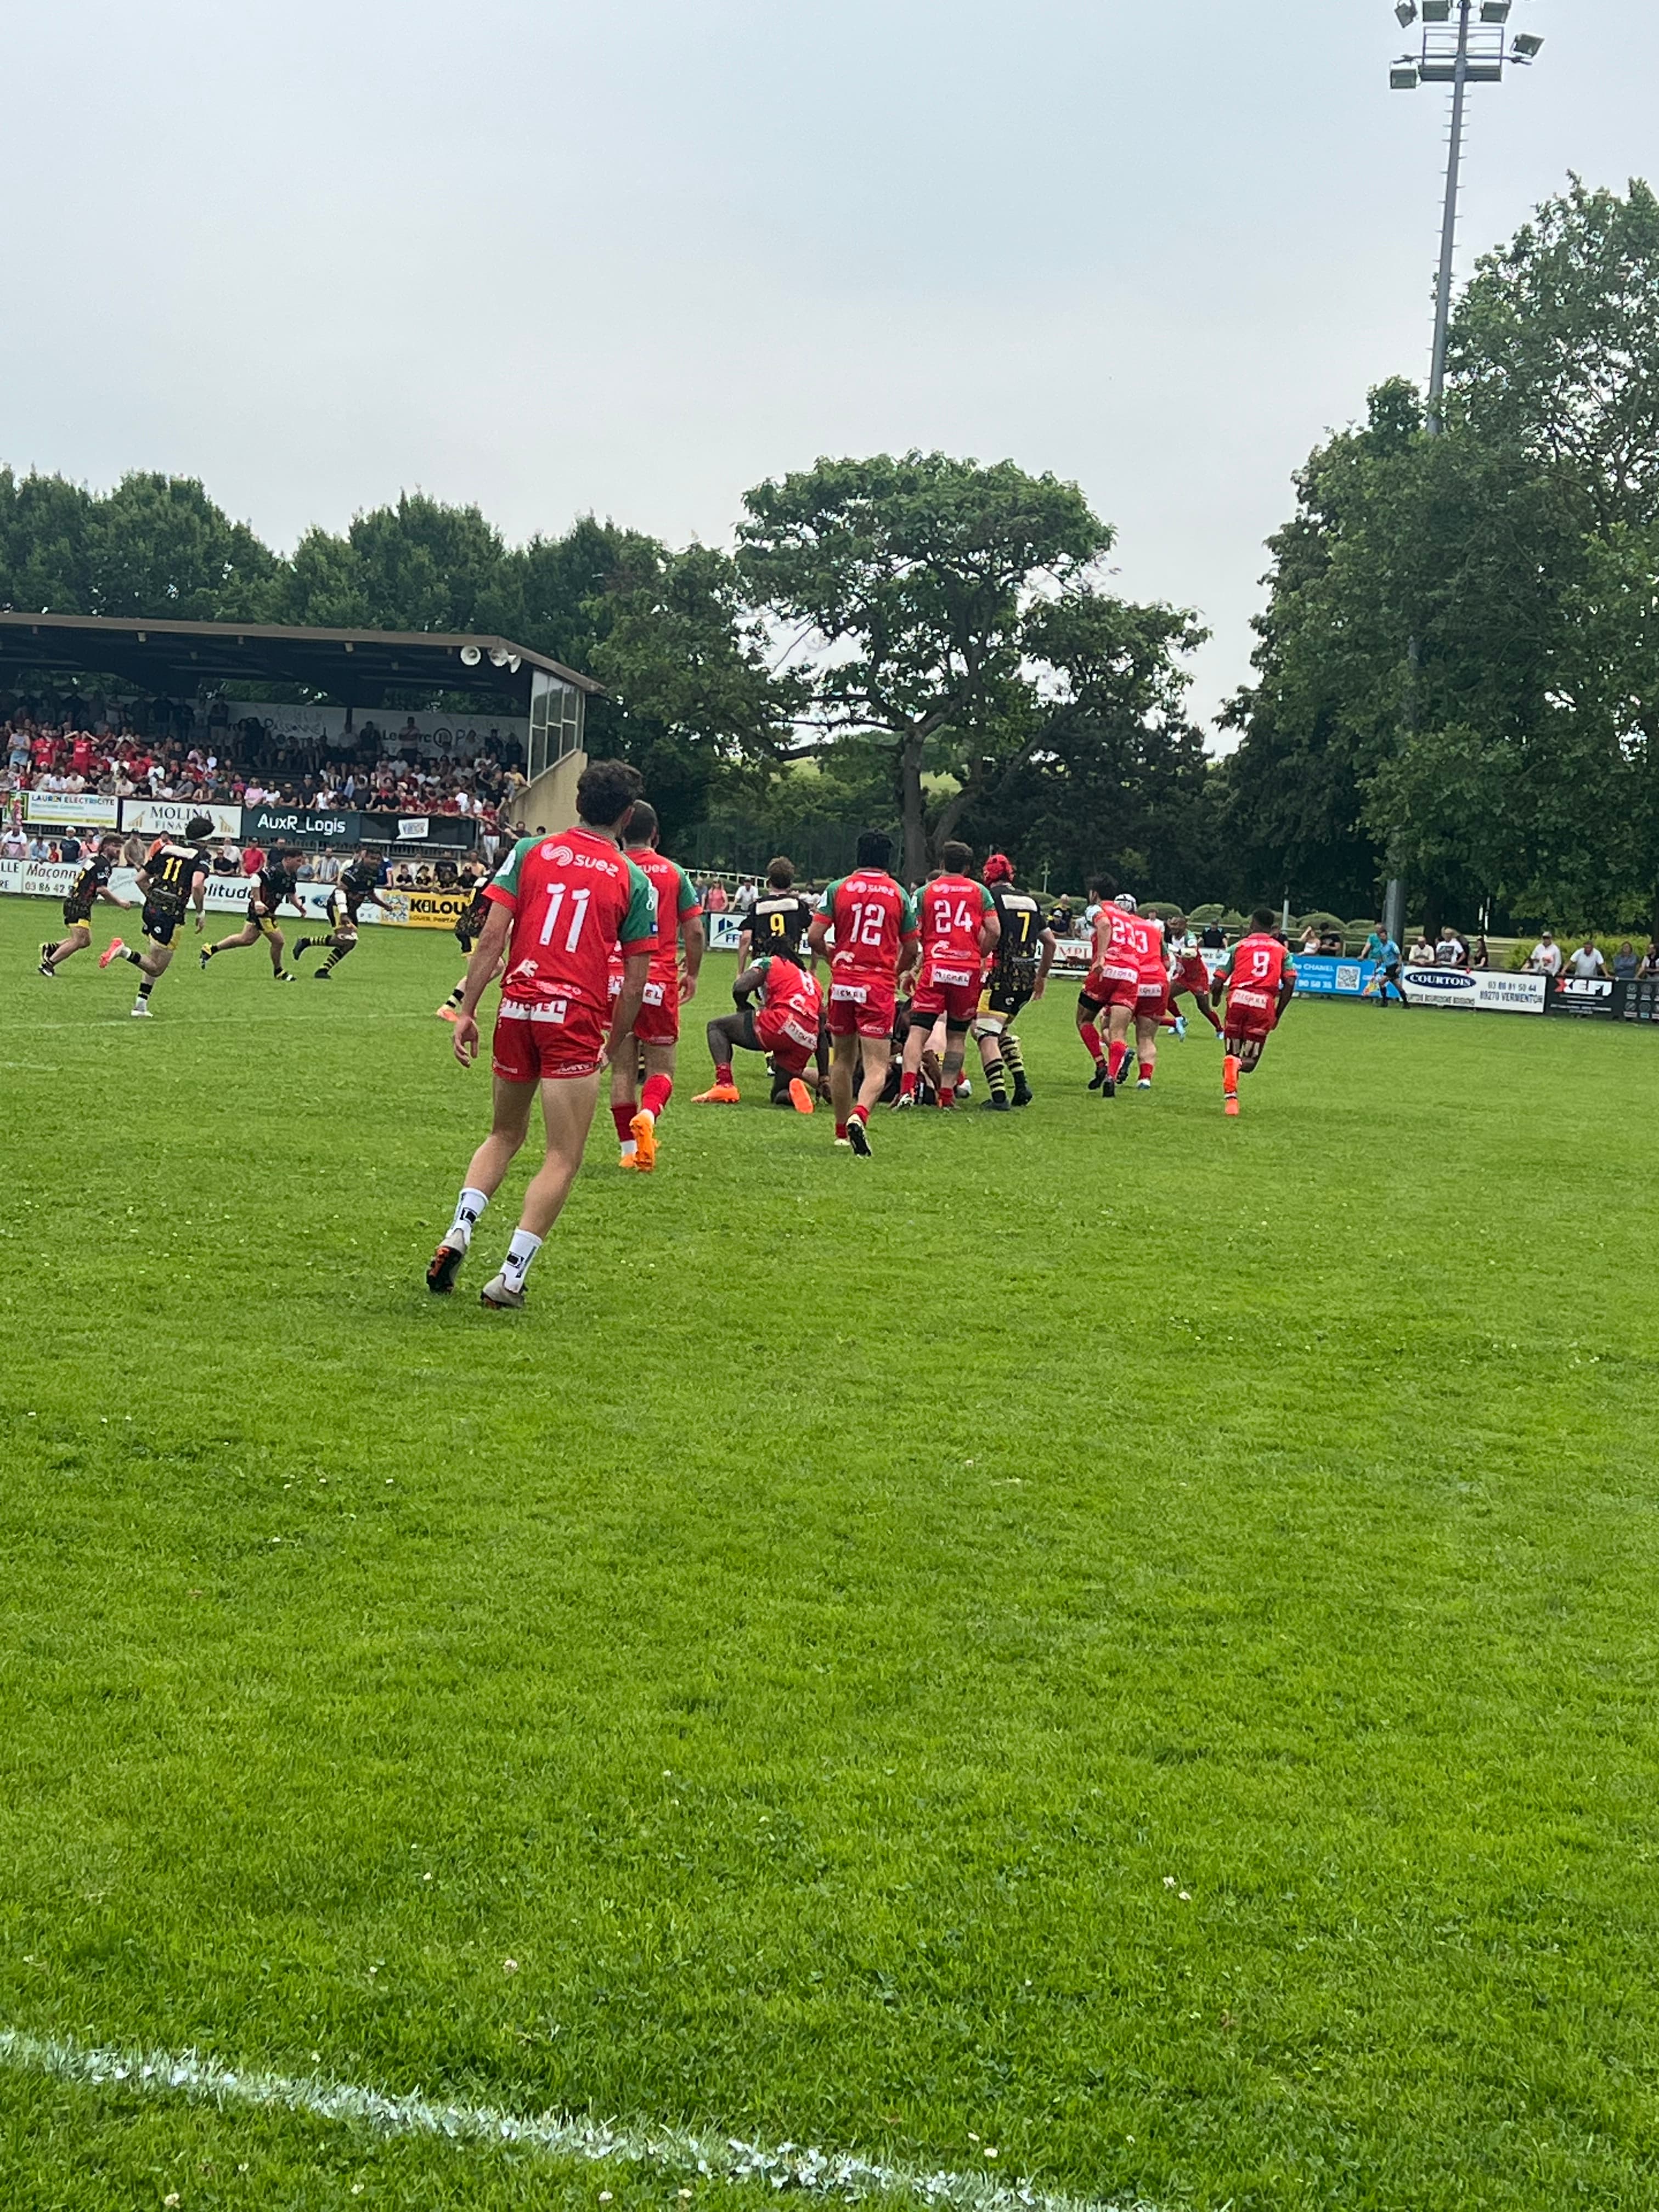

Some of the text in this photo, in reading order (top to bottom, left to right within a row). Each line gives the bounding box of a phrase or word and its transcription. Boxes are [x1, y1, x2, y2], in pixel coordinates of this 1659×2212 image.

[150, 806, 212, 822] MOLINA
[155, 820, 188, 830] FINA
[257, 813, 346, 836] AuxR_Logis
[26, 863, 77, 881] Maçonn
[162, 857, 183, 882] 11
[572, 854, 619, 878] suez
[25, 881, 36, 891] 03
[39, 883, 50, 892] 86
[539, 882, 591, 953] 11
[770, 913, 786, 936] 9
[850, 902, 885, 946] 12
[934, 899, 973, 933] 24
[1017, 911, 1031, 942] 7
[1250, 951, 1270, 978] 9
[1409, 974, 1471, 987] COURTOIS
